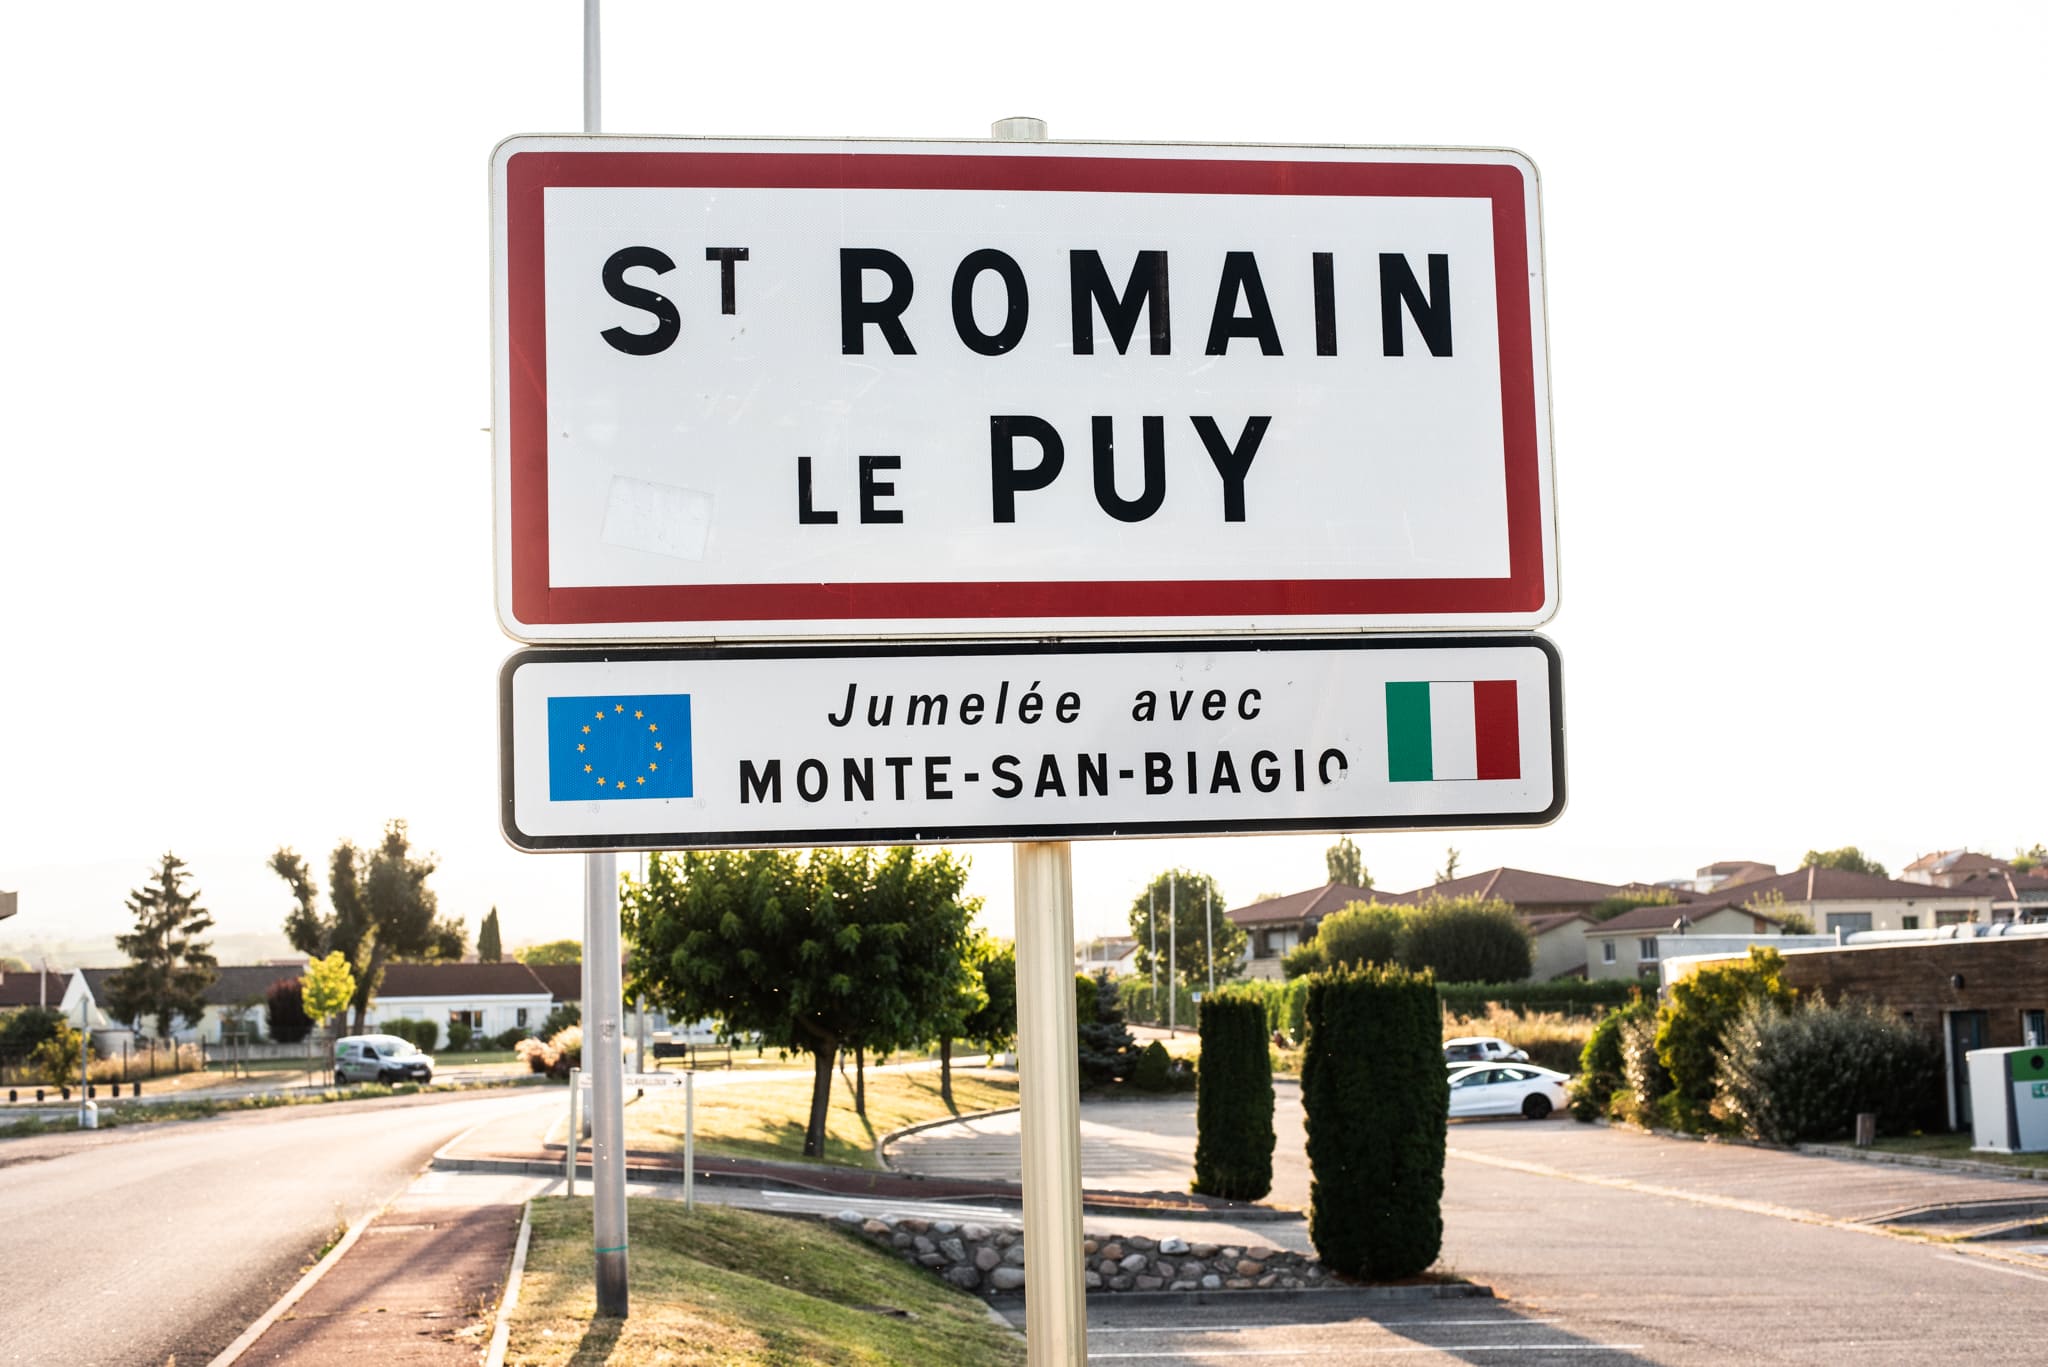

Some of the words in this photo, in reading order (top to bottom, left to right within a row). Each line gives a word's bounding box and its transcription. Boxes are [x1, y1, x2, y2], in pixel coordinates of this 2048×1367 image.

[839, 247, 1454, 358] ROMAIN
[797, 455, 904, 525] LE
[989, 415, 1273, 524] PUY
[827, 680, 1082, 728] Jumelée
[1131, 688, 1263, 722] avec
